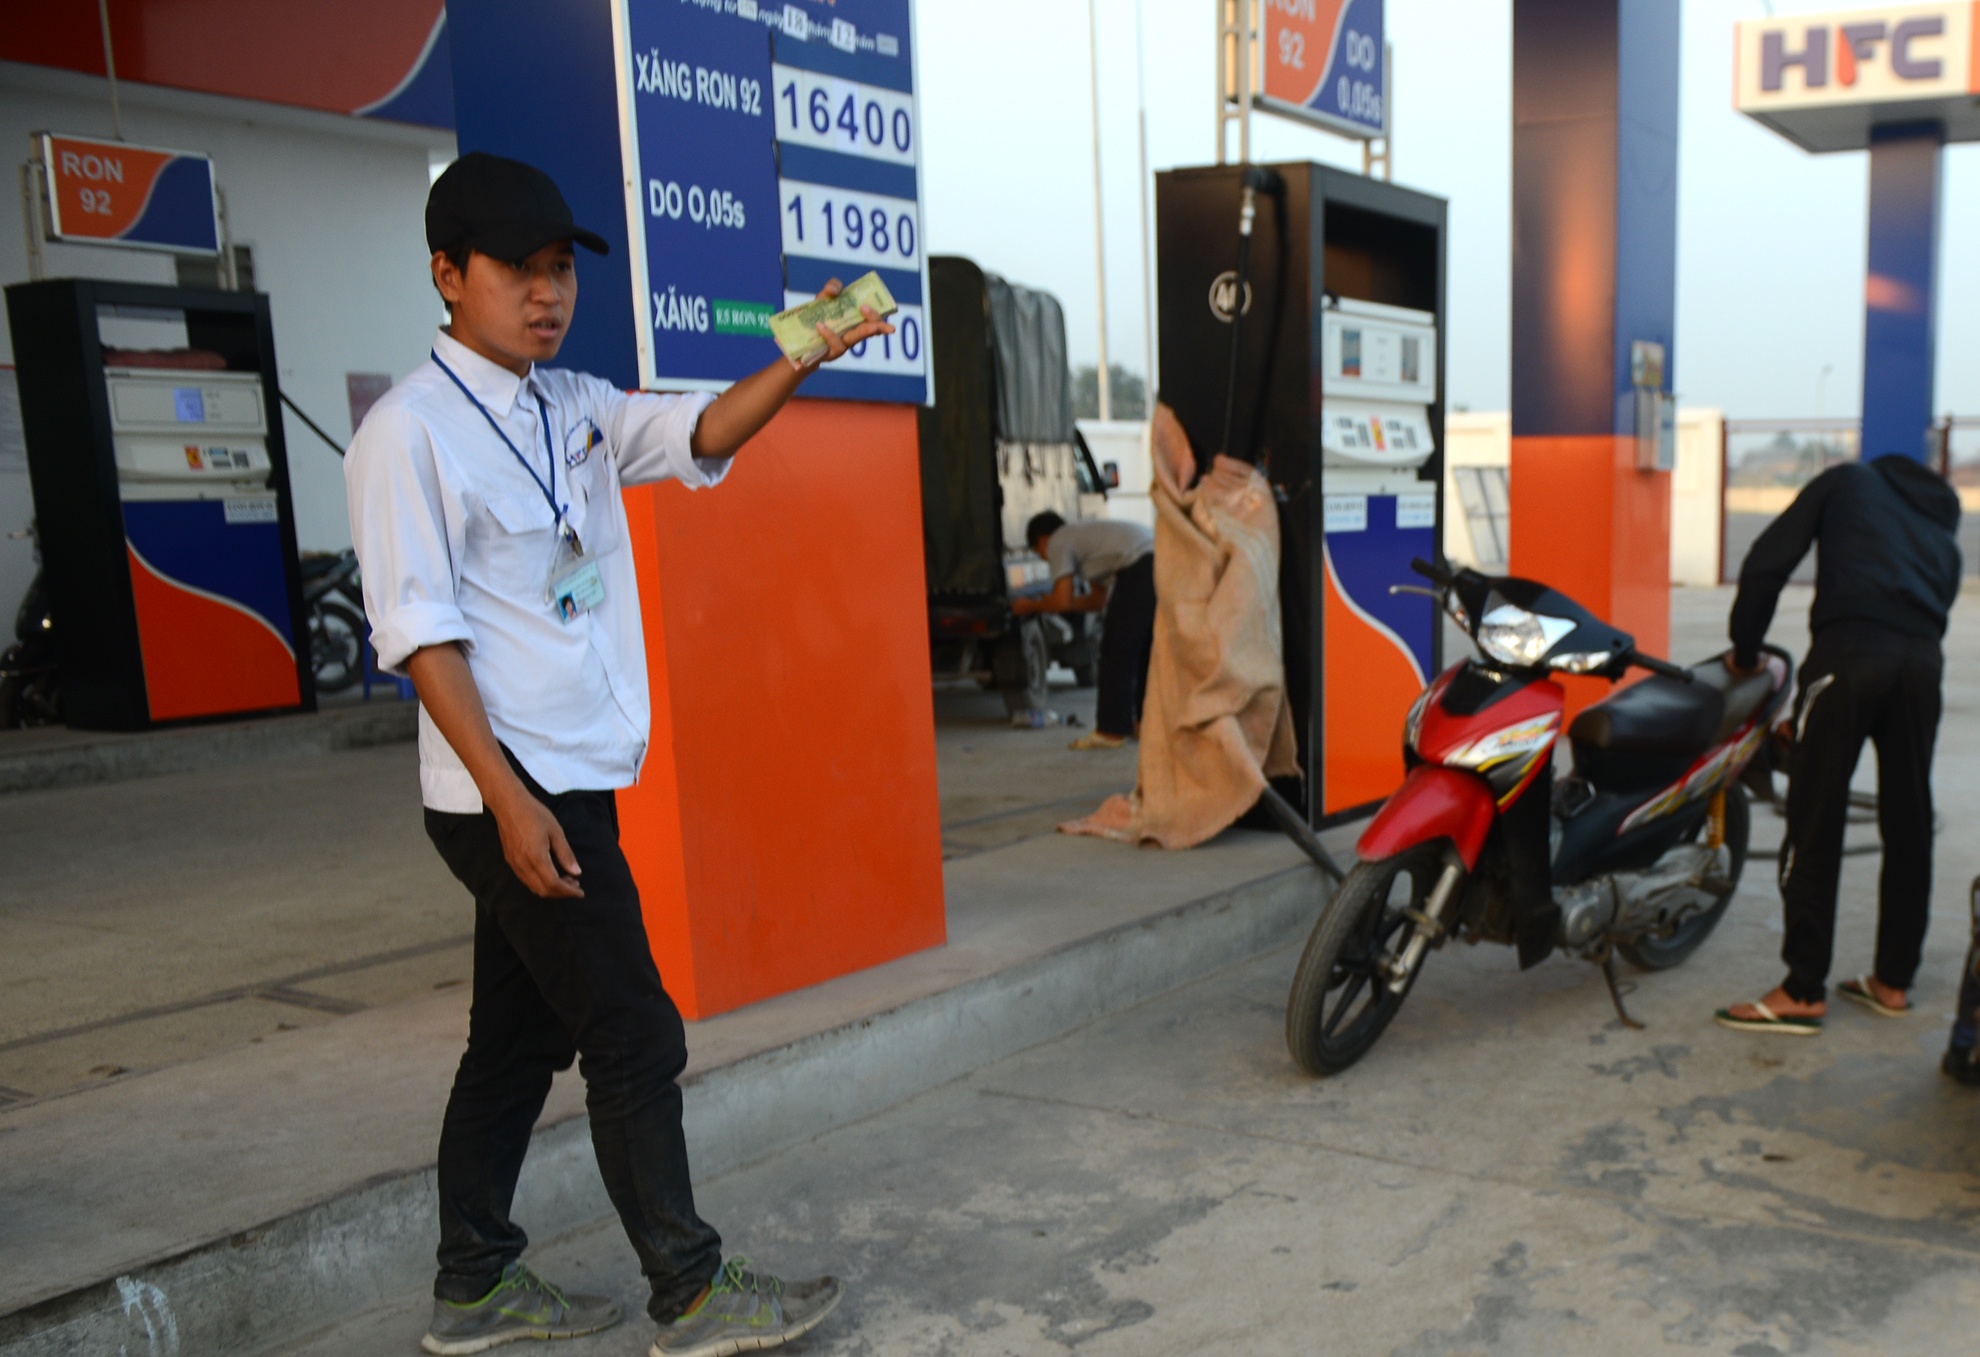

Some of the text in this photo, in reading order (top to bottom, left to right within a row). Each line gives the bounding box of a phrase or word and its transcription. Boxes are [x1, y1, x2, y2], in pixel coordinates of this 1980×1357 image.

[1278, 28, 1304, 69] 92
[1345, 29, 1375, 72] DO
[1761, 16, 1945, 92] HFC
[635, 48, 762, 116] XĂNG RON 92
[782, 81, 911, 153] 16400
[61, 150, 124, 184] RON
[79, 188, 112, 216] 92
[649, 179, 684, 220] DO
[788, 194, 915, 258] 11980
[652, 284, 710, 333] XĂNG
